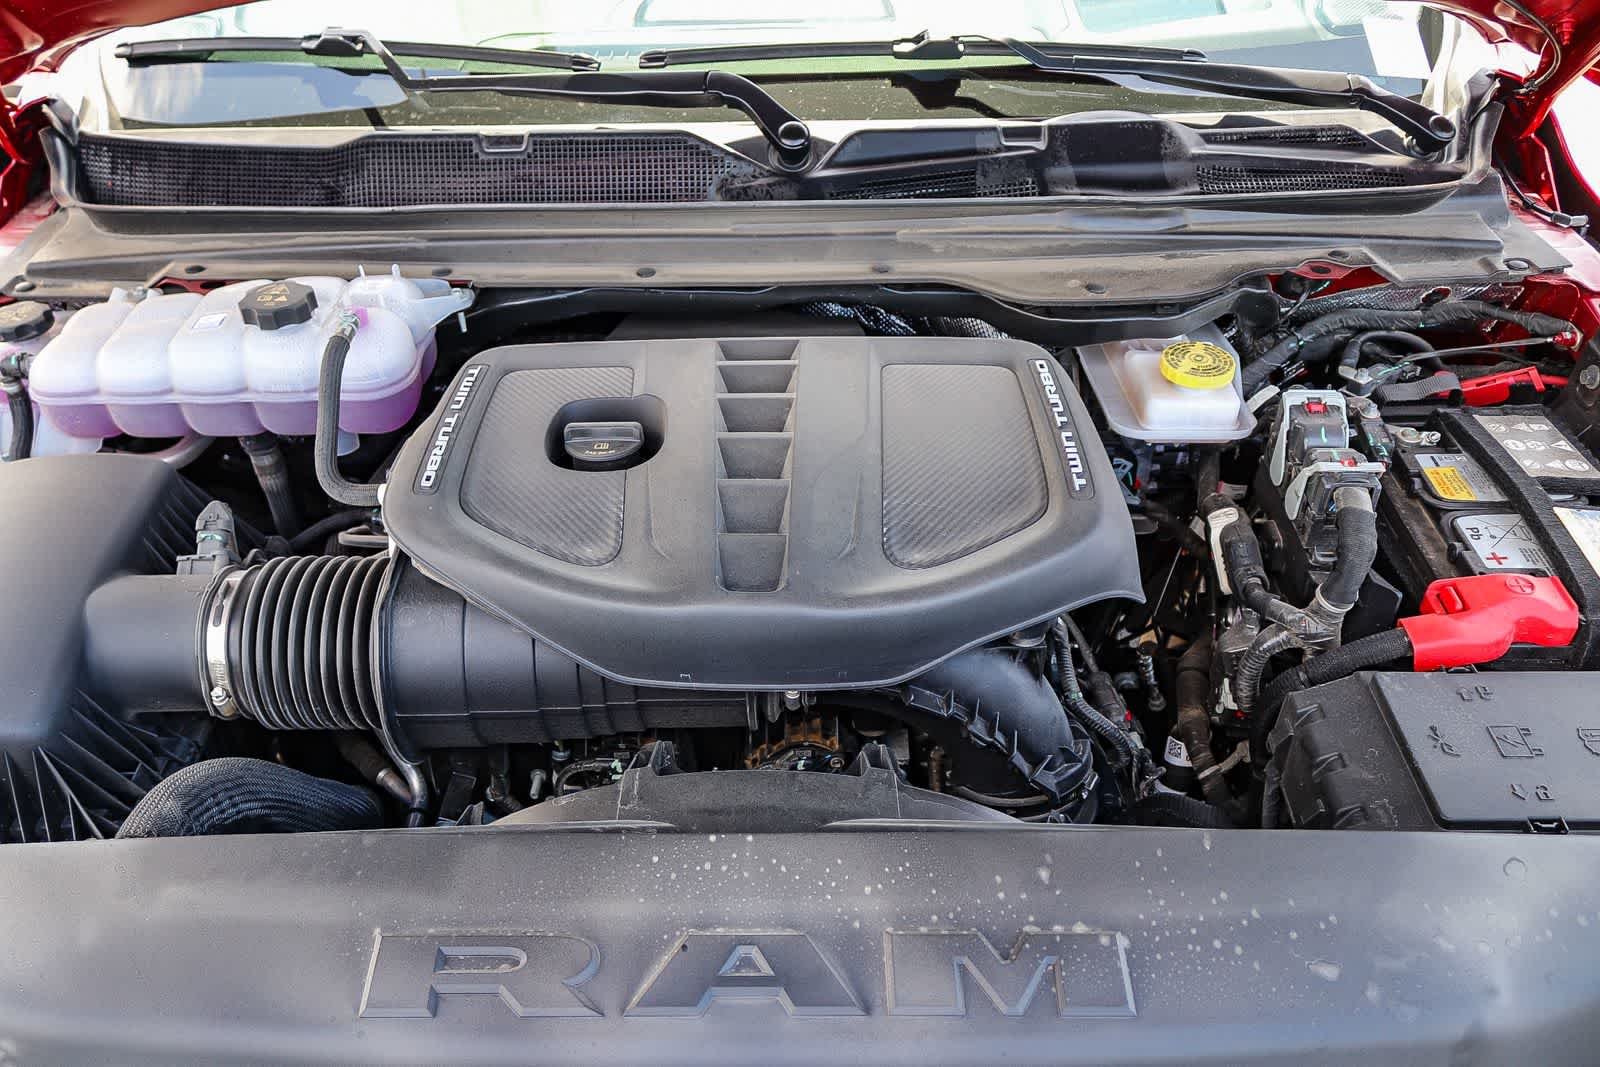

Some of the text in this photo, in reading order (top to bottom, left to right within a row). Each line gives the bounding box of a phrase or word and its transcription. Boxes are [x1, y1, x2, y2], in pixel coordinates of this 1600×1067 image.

[420, 365, 482, 487] TWIN TURBO
[1035, 359, 1087, 491] TWIN TURBO
[1465, 527, 1483, 541] Pb
[358, 929, 1138, 1018] RAM
